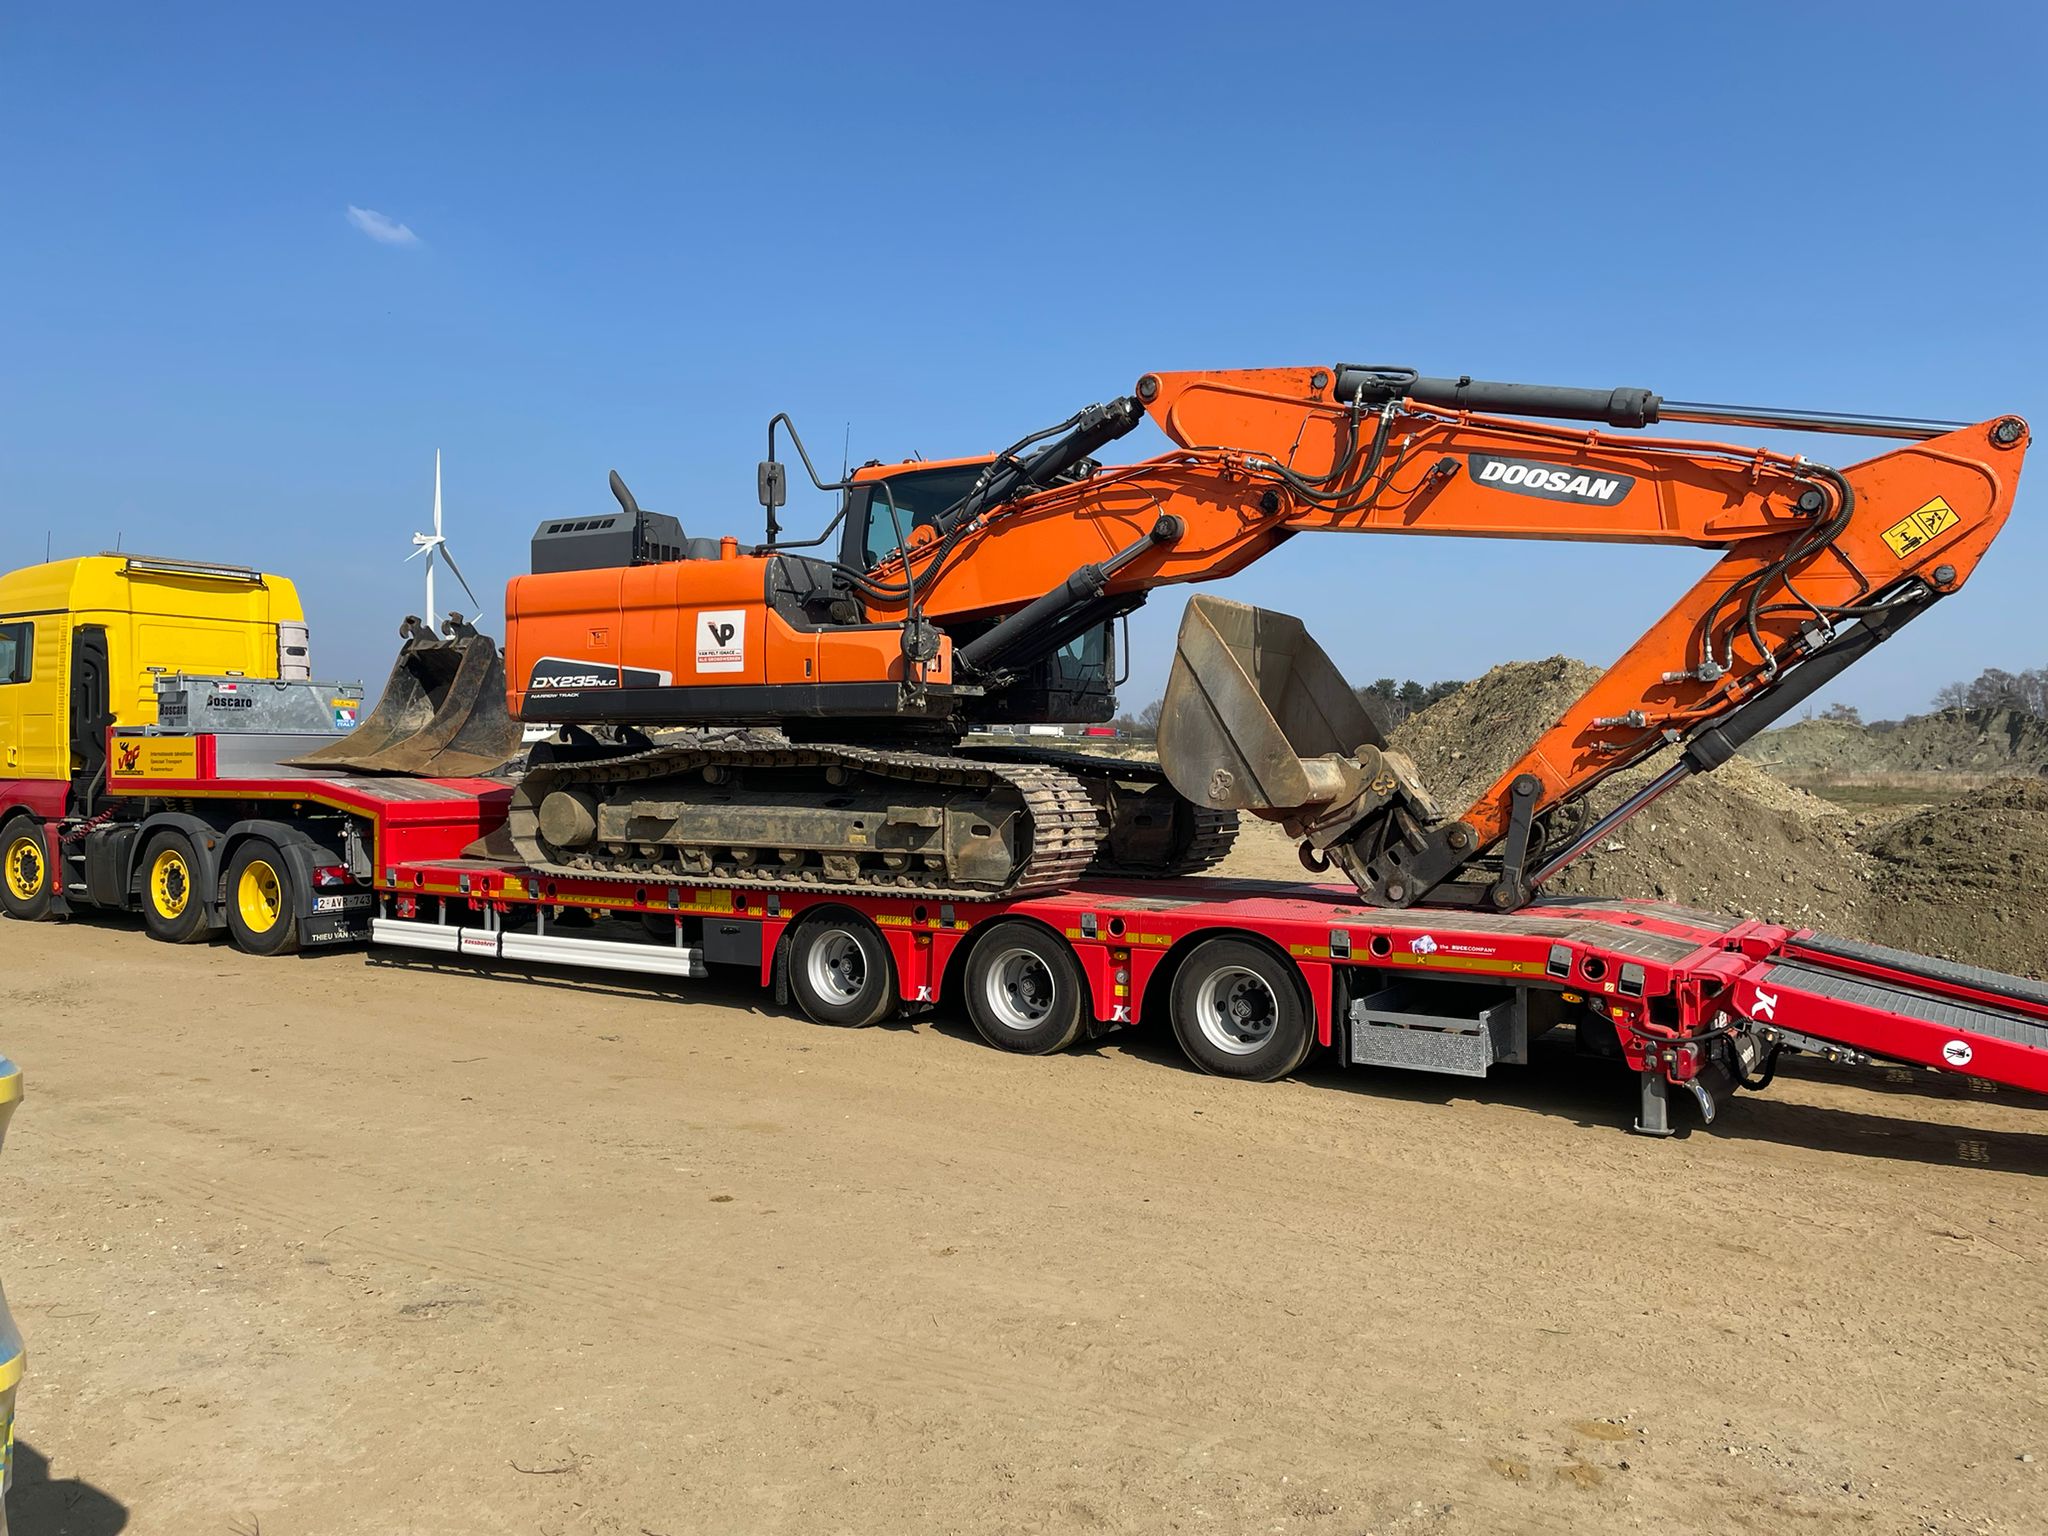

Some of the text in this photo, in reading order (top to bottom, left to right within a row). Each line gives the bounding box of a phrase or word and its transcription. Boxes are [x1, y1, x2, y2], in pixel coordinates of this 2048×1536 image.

[1479, 461, 1620, 500] DOOSAN
[312, 932, 333, 942] THIEU
[334, 930, 349, 939] VAN
